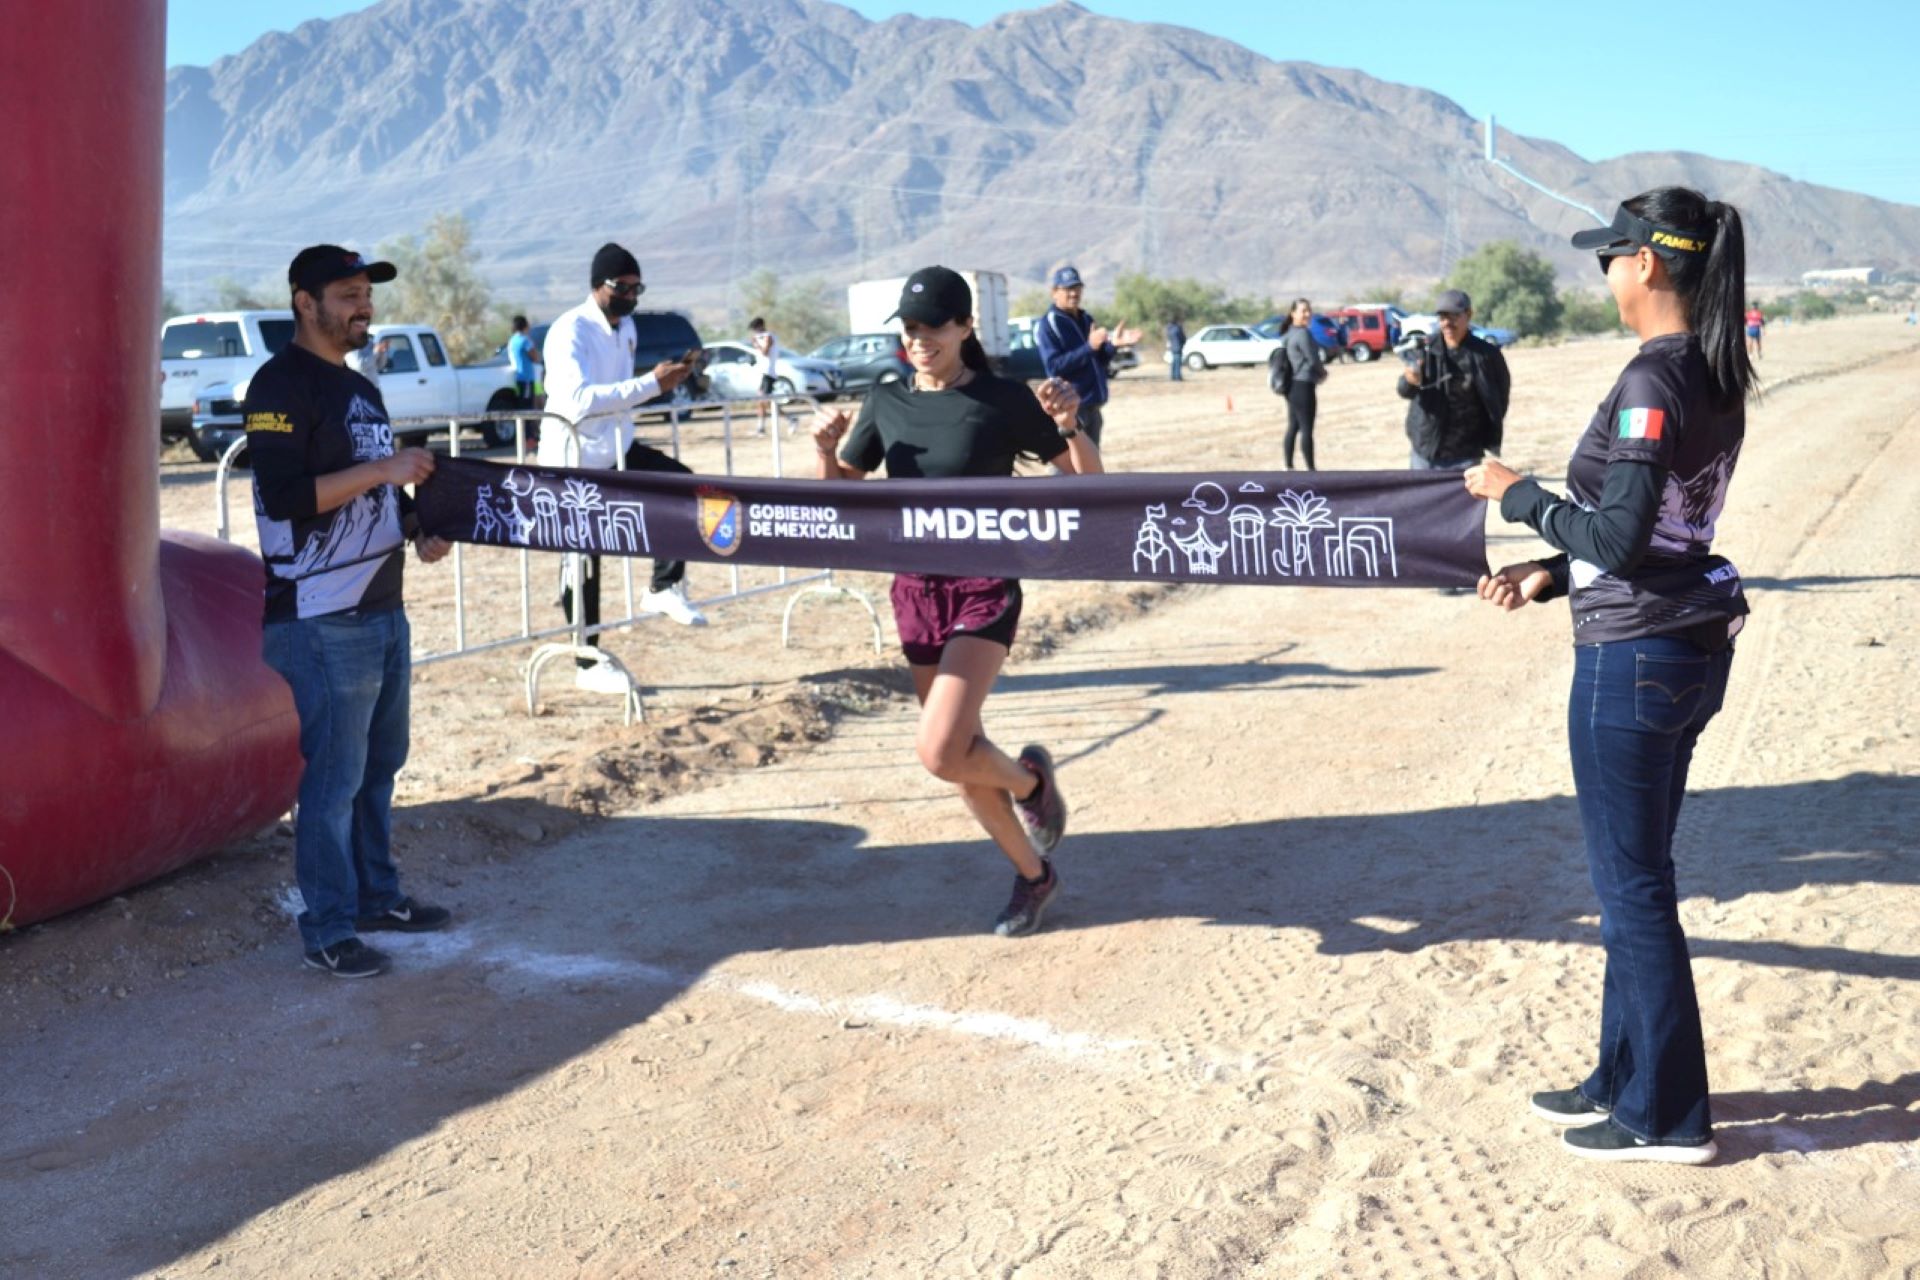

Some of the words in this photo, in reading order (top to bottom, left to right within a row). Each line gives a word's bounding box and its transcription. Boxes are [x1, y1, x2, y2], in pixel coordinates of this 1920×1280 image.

[1651, 231, 1706, 251] FAMILY
[246, 412, 287, 423] FAMILY
[372, 423, 393, 445] 10
[749, 503, 838, 523] GOBIERNO
[750, 521, 773, 537] DE
[774, 522, 856, 541] MEXICALI
[902, 507, 1081, 542] IMDECUF
